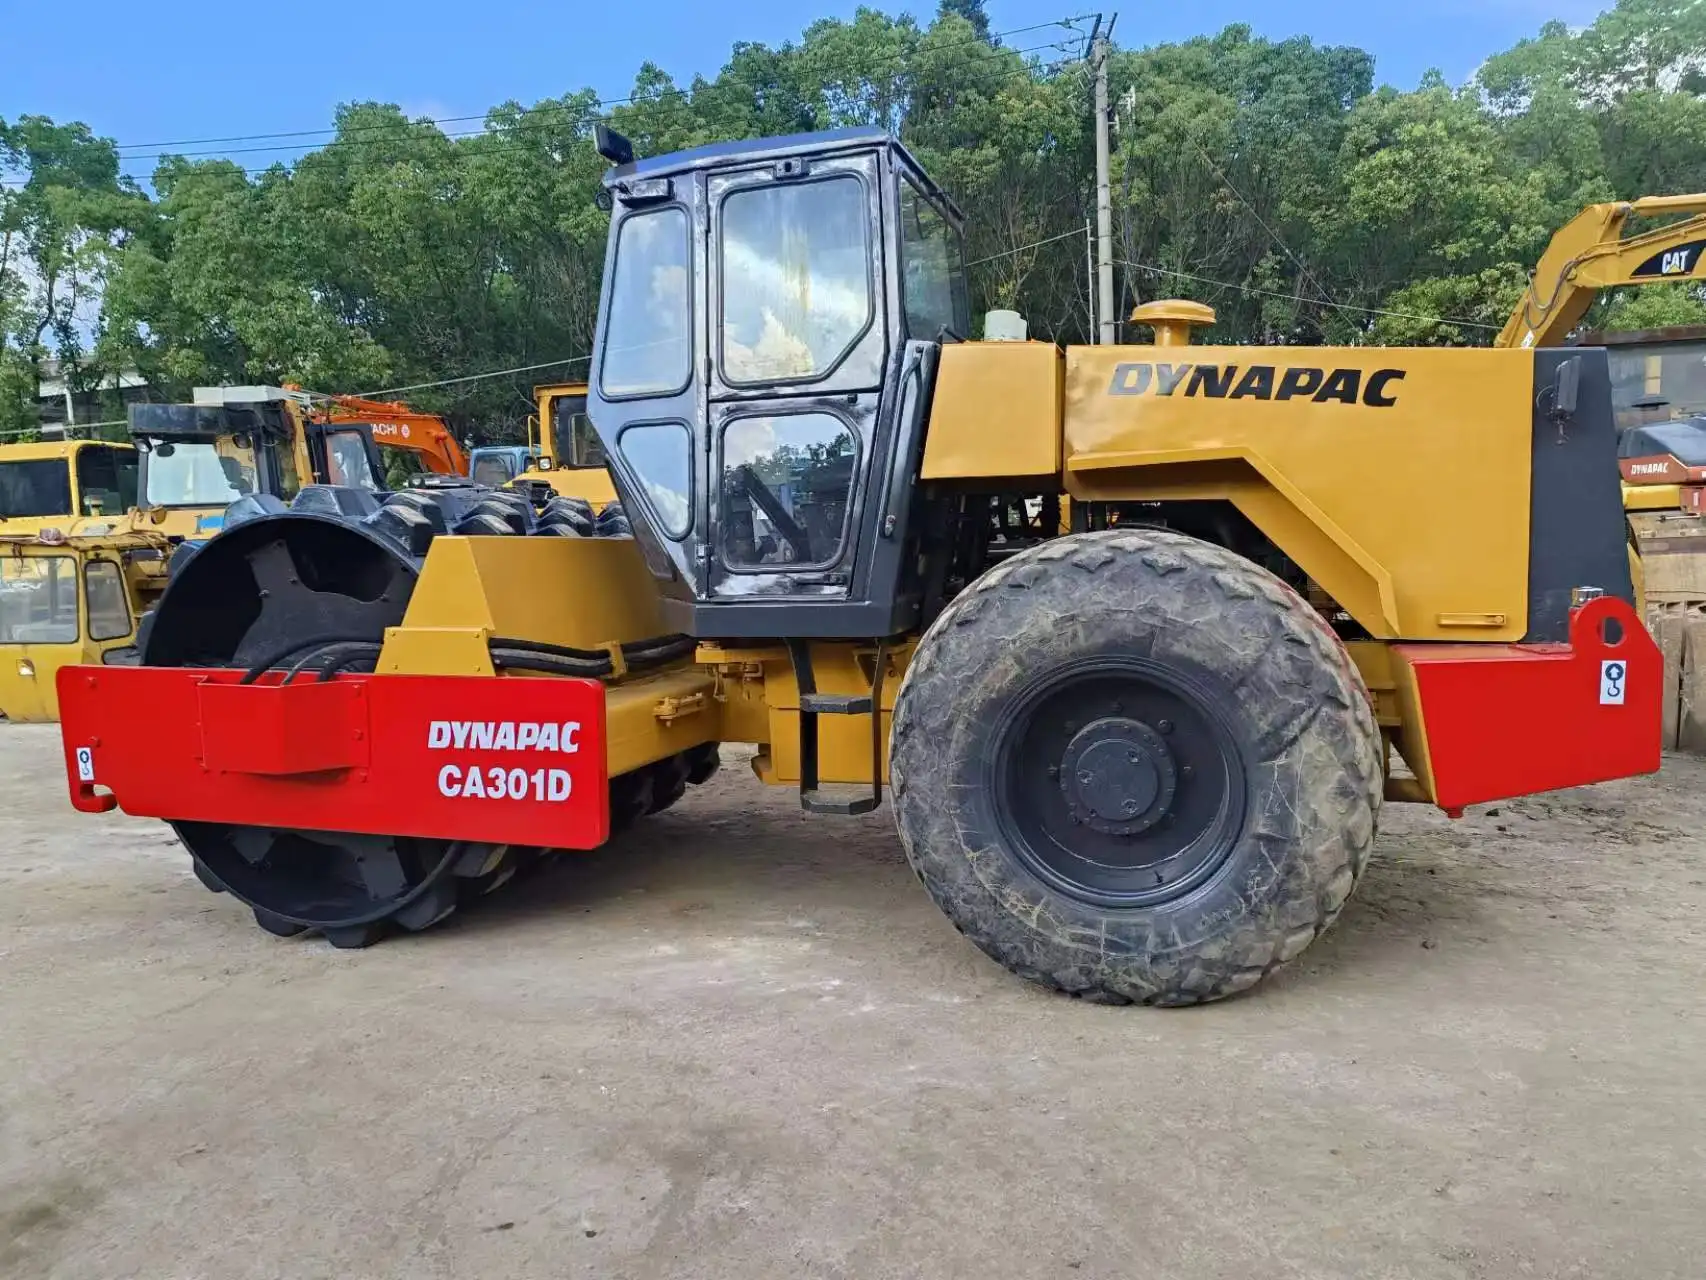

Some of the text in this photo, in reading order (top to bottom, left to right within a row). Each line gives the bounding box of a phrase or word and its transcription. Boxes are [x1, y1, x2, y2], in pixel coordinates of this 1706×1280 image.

[1662, 249, 1690, 273] CAT
[1108, 363, 1406, 407] DYNAPAC
[371, 423, 397, 436] ACHI
[1631, 462, 1668, 475] DYNAPAC
[428, 721, 580, 753] DYNAPAC
[438, 765, 572, 802] CA301D
